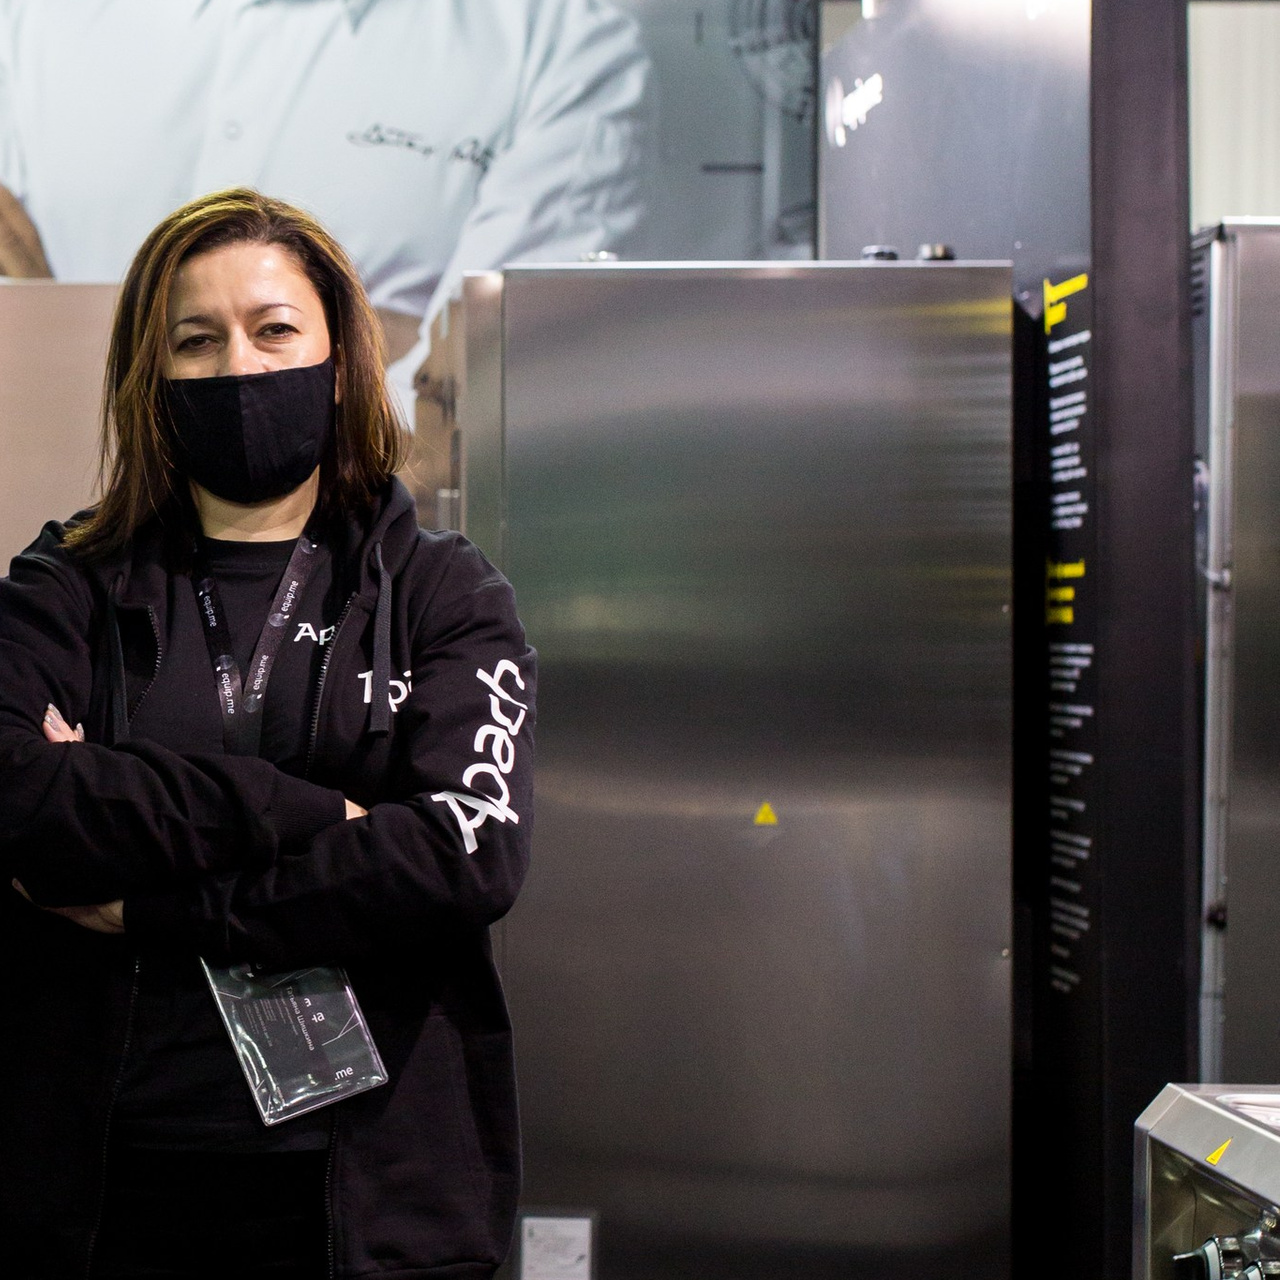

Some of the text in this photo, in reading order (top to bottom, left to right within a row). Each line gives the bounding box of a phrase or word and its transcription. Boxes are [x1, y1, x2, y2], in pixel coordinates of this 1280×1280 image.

[204, 595, 217, 628] equip.me
[281, 580, 299, 612] equip.me
[253, 654, 269, 691] equip.me
[221, 672, 235, 715] equip.me
[431, 658, 529, 855] Apach
